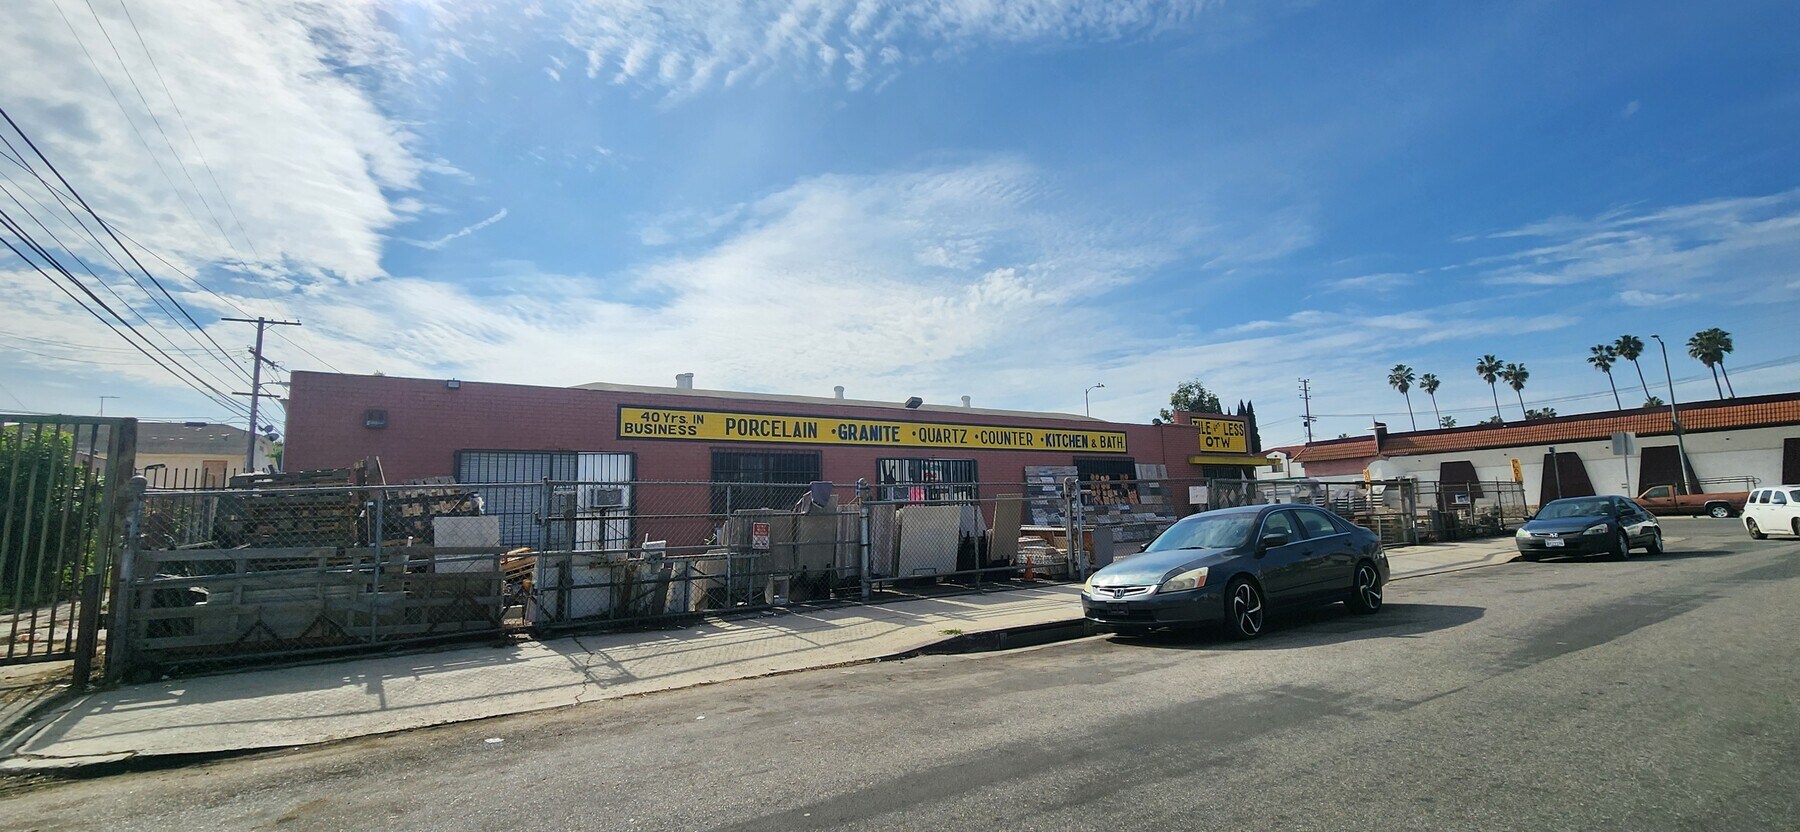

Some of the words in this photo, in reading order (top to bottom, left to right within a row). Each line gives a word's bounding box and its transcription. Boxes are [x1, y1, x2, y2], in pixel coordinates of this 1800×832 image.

[641, 412, 660, 423] 40
[663, 413, 688, 424] Yrs.
[693, 414, 704, 424] IN
[624, 422, 697, 436] BUSINESS
[725, 418, 818, 438] PORCELAIN
[838, 423, 900, 442] GRANITE
[919, 427, 968, 444] QUARTZ
[980, 430, 1034, 446] COUNTER
[1045, 434, 1088, 448] KITCHEN
[1091, 440, 1098, 448] &
[1223, 423, 1244, 436] LESS
[1205, 437, 1230, 448] OTW
